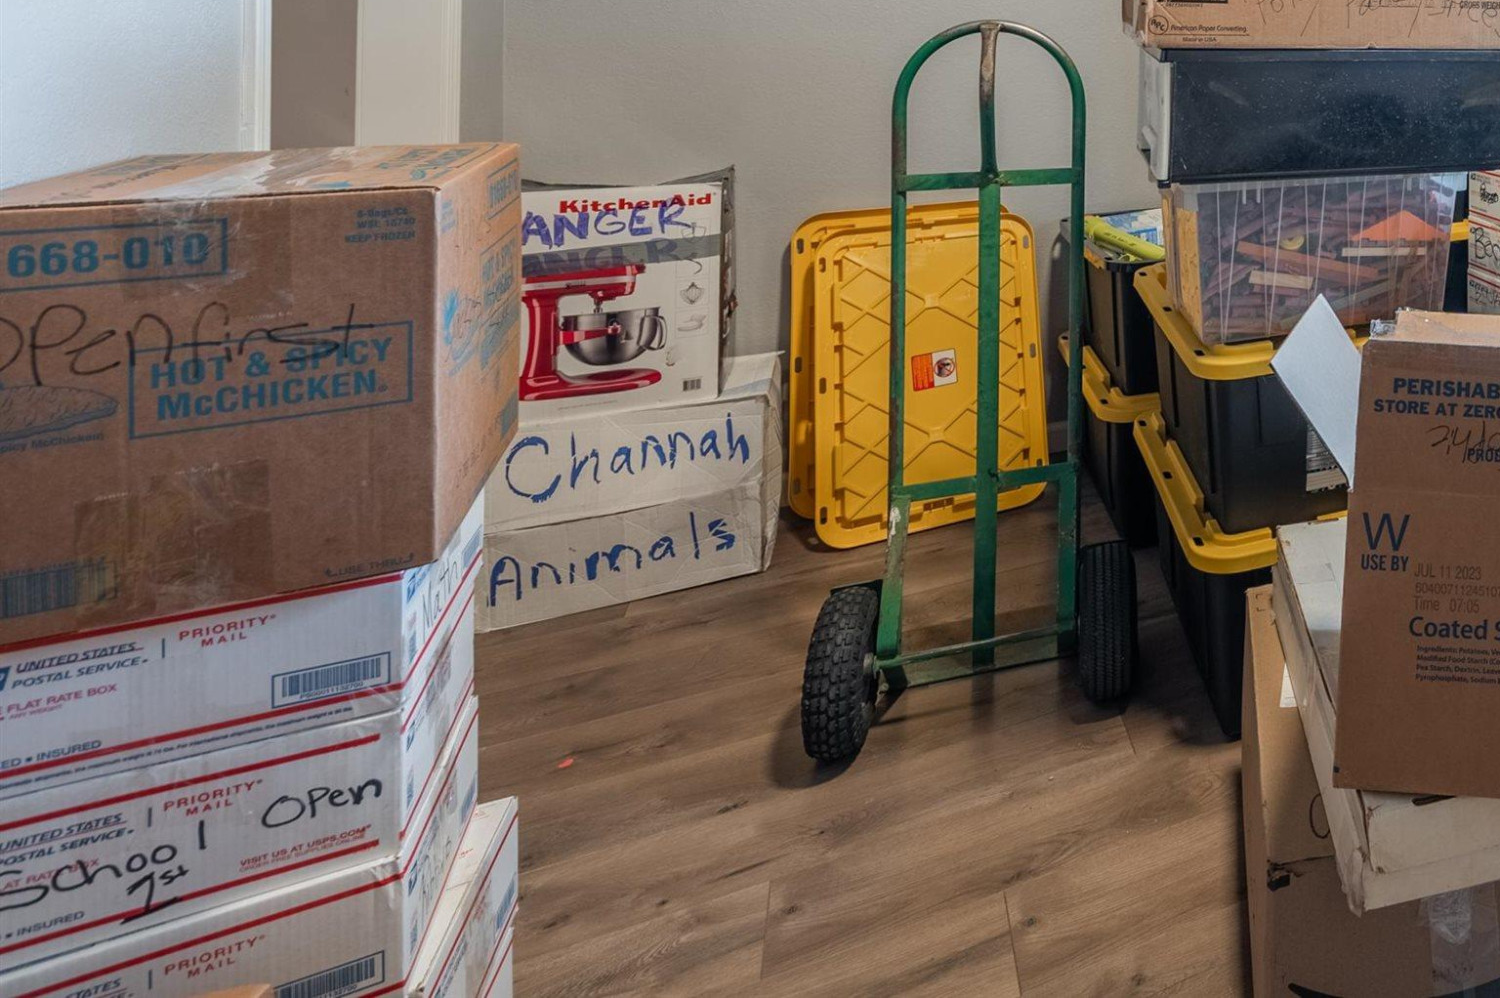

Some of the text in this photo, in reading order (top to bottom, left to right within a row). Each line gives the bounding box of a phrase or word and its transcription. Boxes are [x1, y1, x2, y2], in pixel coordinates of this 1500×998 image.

[559, 193, 712, 213] KitchenAid
[7, 232, 209, 278] 668-010
[152, 337, 393, 389] HOT & SPICY
[1374, 399, 1429, 415] STORE
[1435, 403, 1458, 416] AT
[505, 412, 750, 503] Channah
[1362, 512, 1411, 551] W
[487, 511, 736, 607] Animals
[1361, 554, 1409, 572] USE BY
[1414, 563, 1482, 581] JUL 11 2023
[1414, 596, 1480, 614] Time 07:05
[179, 615, 268, 642] PRIORITY
[201, 632, 248, 648] MAIL
[1408, 616, 1488, 641] Coated
[16, 642, 136, 674] UNITED STATES
[12, 656, 142, 690] POSTAL SERVICE
[7, 684, 118, 714] FLAT RATE BOX
[36, 740, 102, 762] INSURED
[163, 780, 256, 811] PRIORITY
[186, 799, 233, 817] MAIL
[0, 813, 123, 852] UNITED STATES
[60, 829, 124, 852] SERVICE
[240, 854, 268, 866] VISIT
[271, 848, 287, 859] US
[290, 844, 304, 854] AT
[17, 911, 85, 936] INSURED
[164, 936, 258, 976] PRIORITY
[187, 958, 235, 979] MAIL
